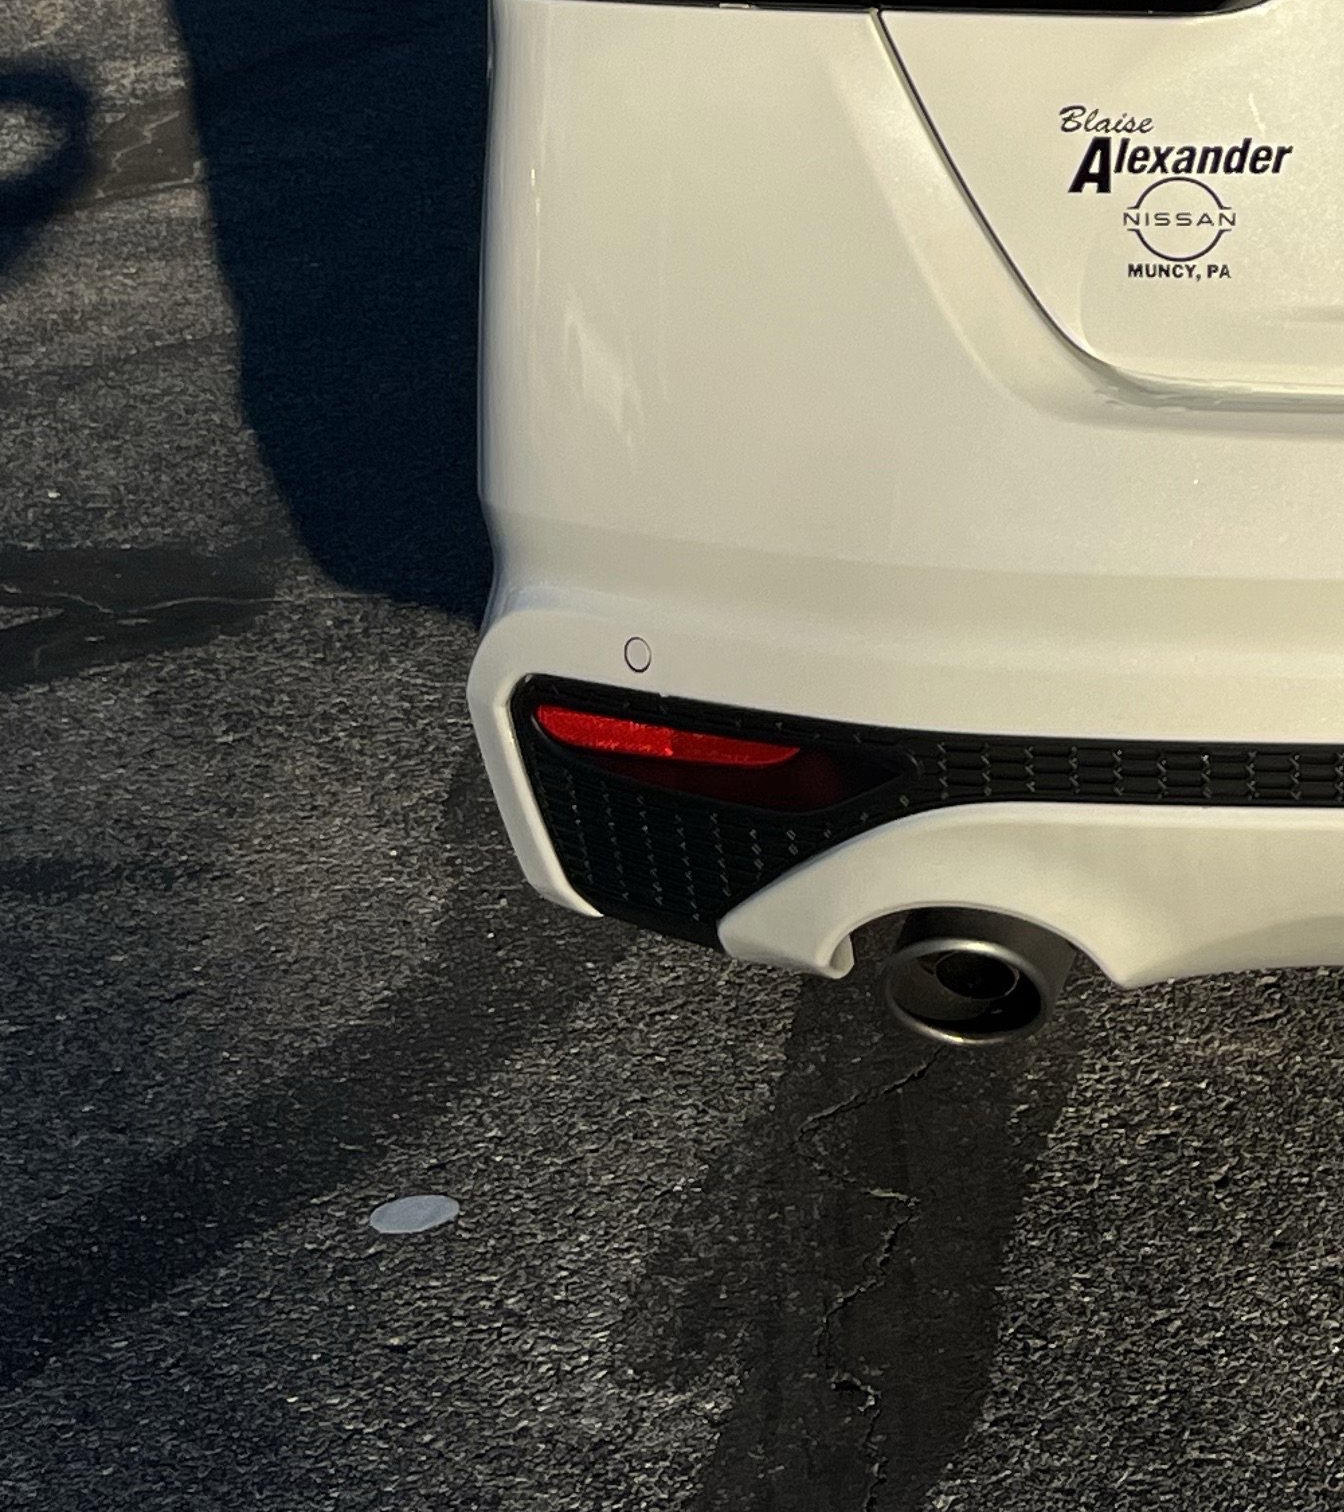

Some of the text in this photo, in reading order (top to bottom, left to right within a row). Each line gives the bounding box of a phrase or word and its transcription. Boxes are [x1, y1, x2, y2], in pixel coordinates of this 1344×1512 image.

[1058, 104, 1155, 135] Blaise
[1067, 136, 1294, 194] Alexander
[1122, 212, 1237, 227] NISSAN
[1127, 263, 1232, 282] MUNCY, PA
